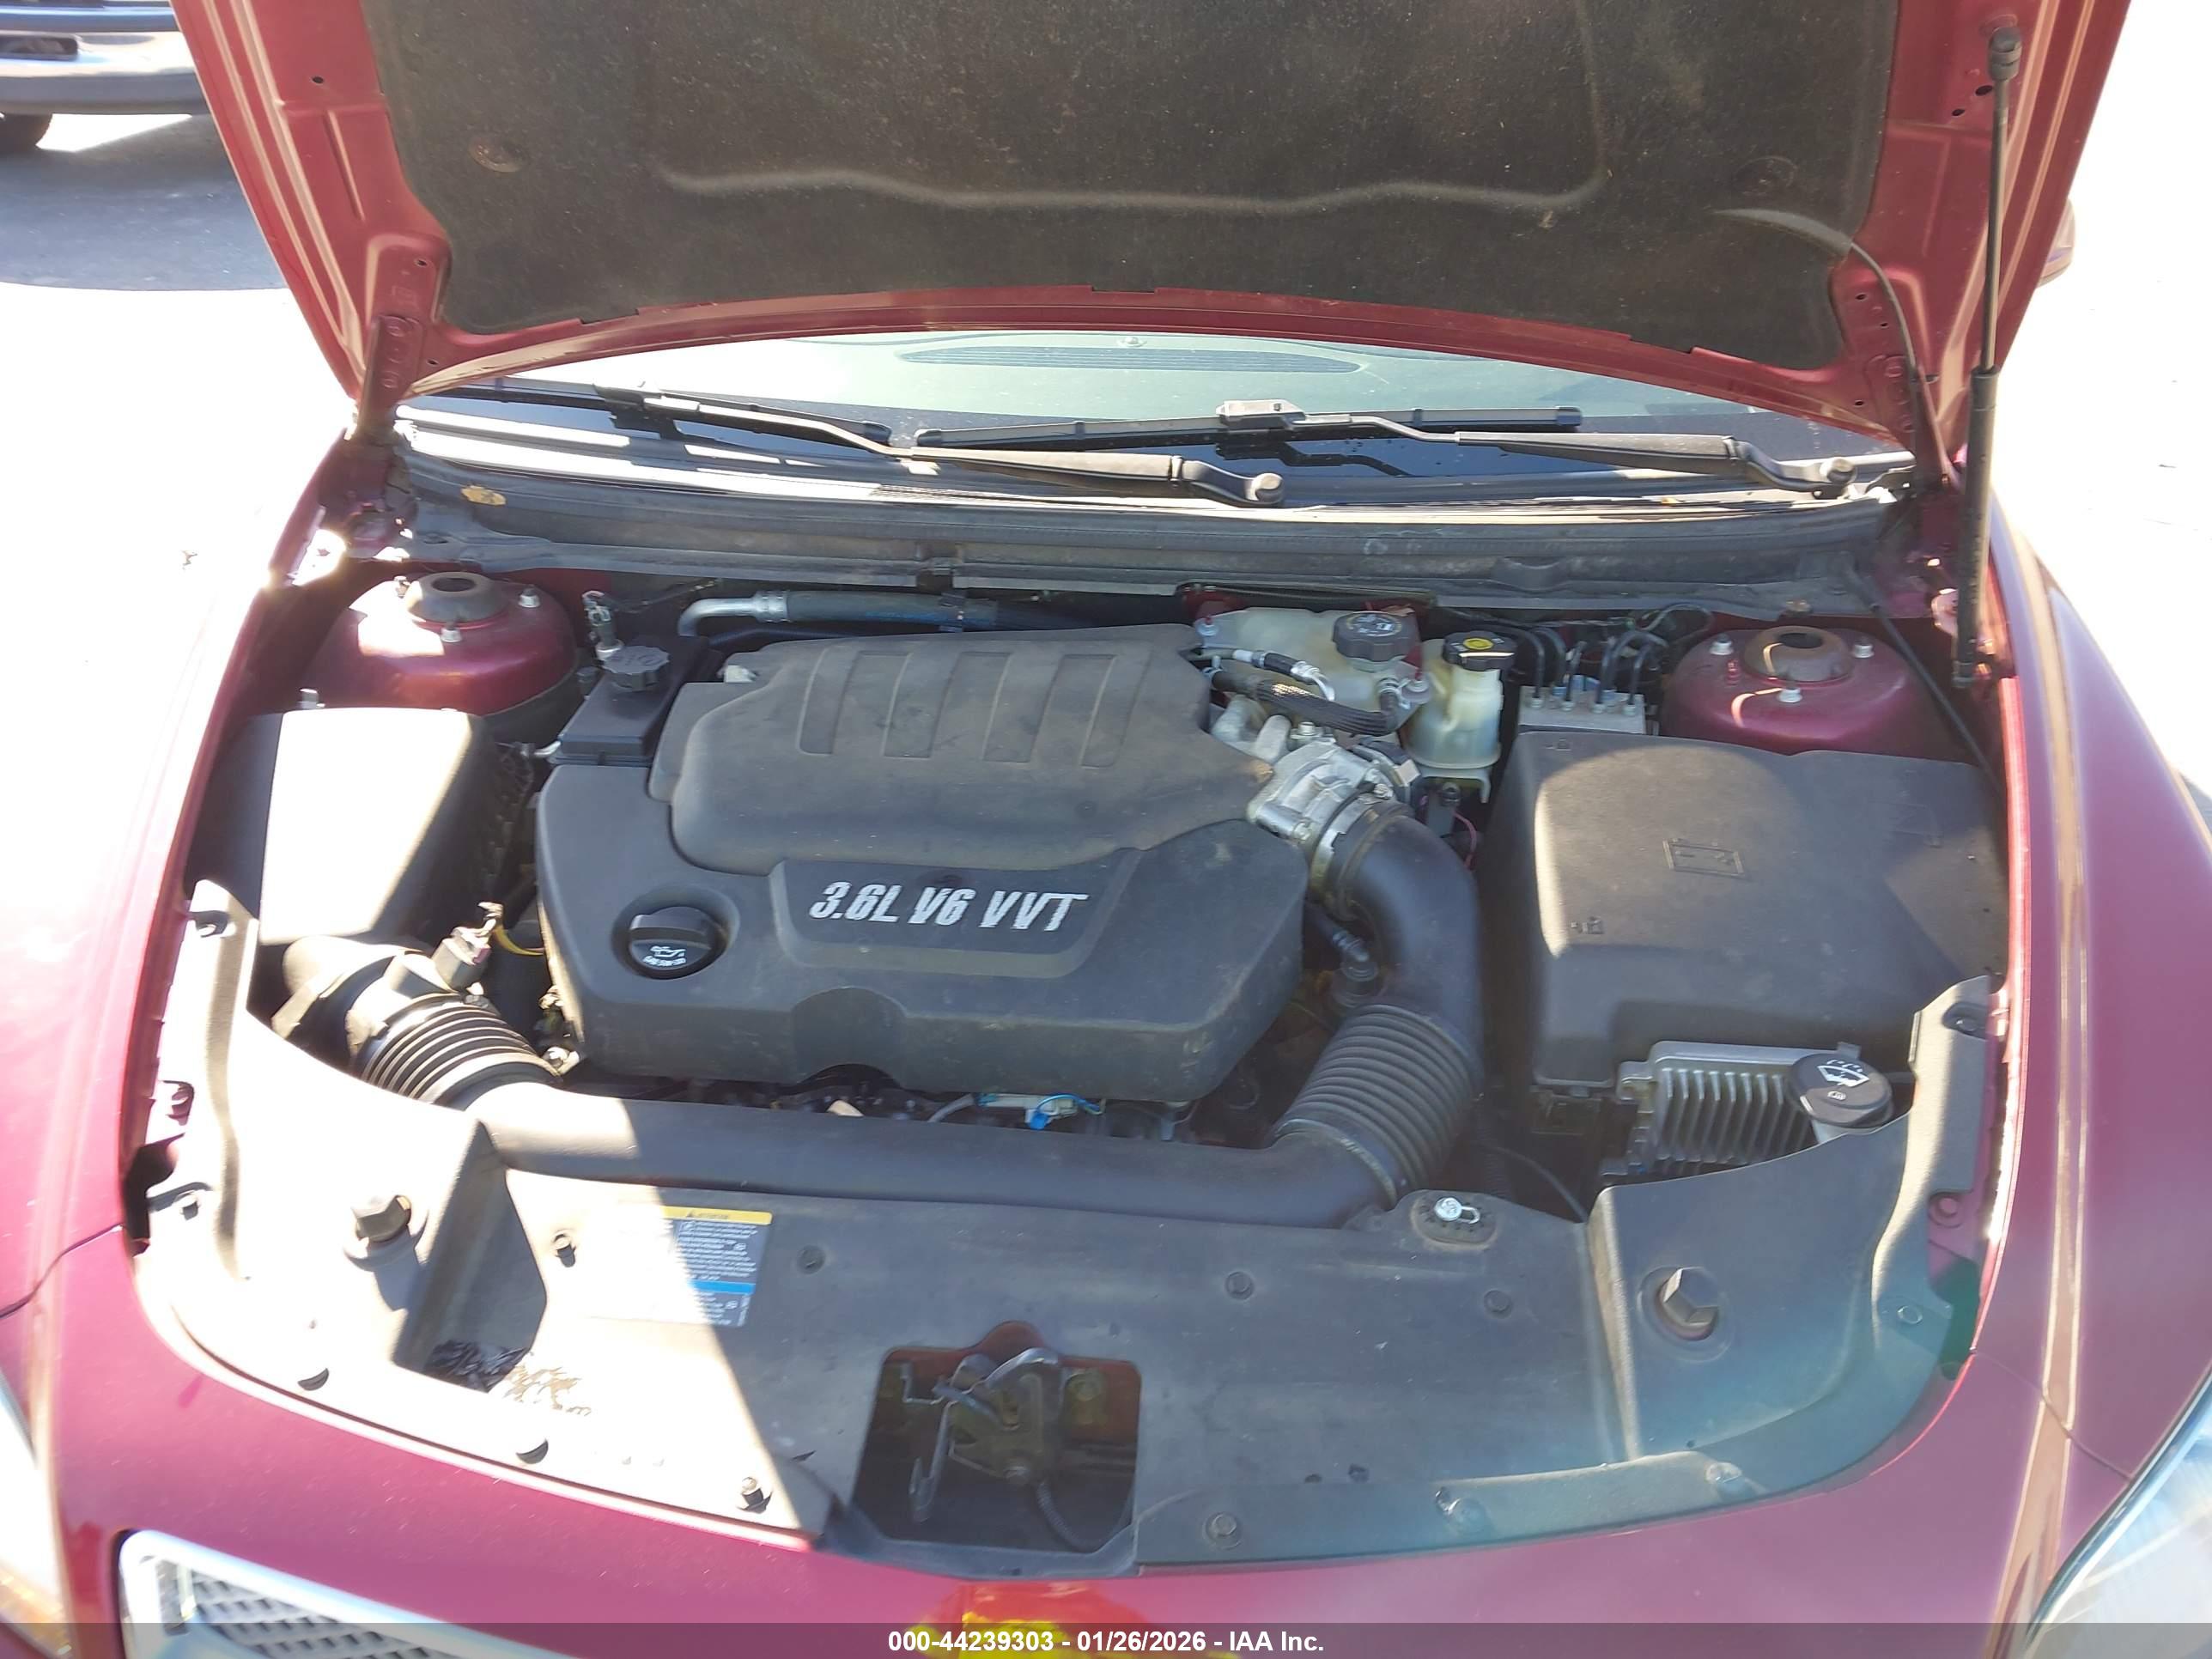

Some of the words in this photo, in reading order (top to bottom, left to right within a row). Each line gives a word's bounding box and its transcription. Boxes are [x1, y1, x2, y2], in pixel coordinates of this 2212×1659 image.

[809, 881, 902, 923] 3.6L
[908, 885, 975, 926] V6
[979, 890, 1089, 932] VVT
